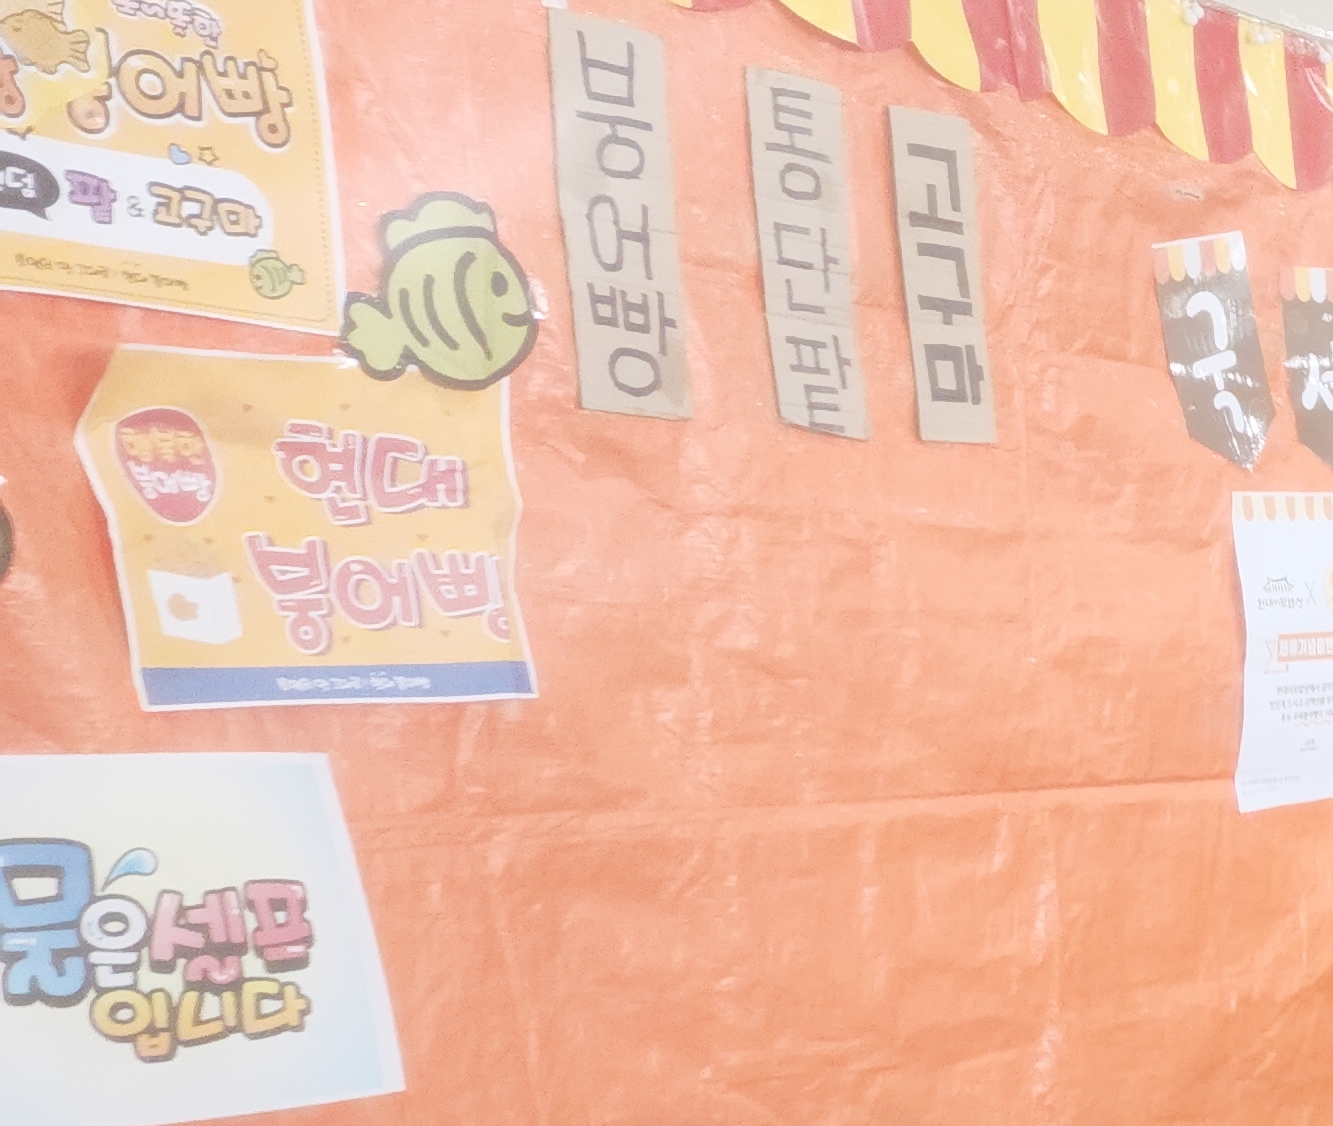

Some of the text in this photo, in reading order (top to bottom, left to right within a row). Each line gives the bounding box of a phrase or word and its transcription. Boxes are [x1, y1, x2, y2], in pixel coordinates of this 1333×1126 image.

[146, 180, 263, 238] 고구마
[575, 30, 678, 398] 붕어빵
[765, 86, 853, 434] 통단팥
[906, 142, 984, 405] 고구마
[273, 420, 470, 526] 현대
[242, 531, 511, 655] 붕어빵
[148, 879, 315, 985] 셀프
[89, 979, 312, 1063] 입니다
